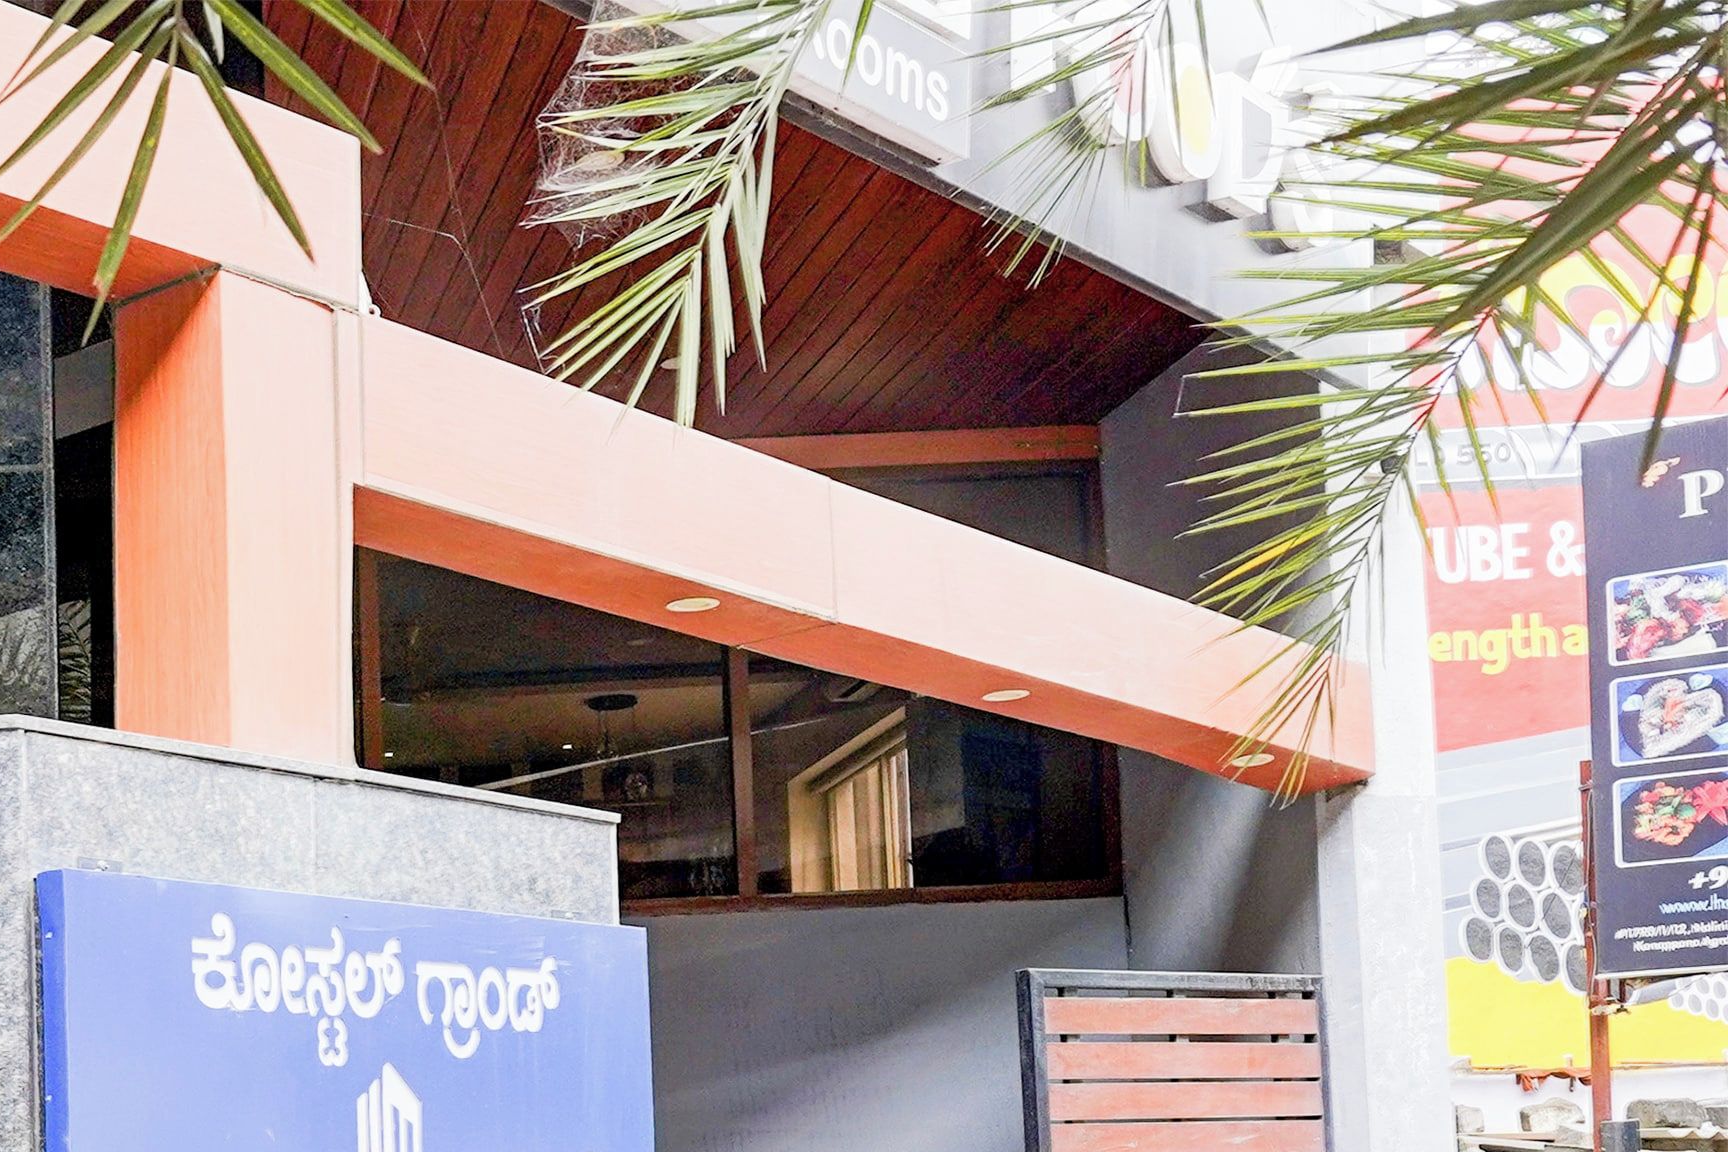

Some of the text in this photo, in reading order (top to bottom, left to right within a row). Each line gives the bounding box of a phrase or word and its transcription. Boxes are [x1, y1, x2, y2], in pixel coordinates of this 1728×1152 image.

[812, 18, 949, 121] ooms
[1425, 523, 1533, 584] UBE
[191, 912, 561, 1067] ಕೋಸ್ಟಲ್ ಗ್ರಾಂಡ್
